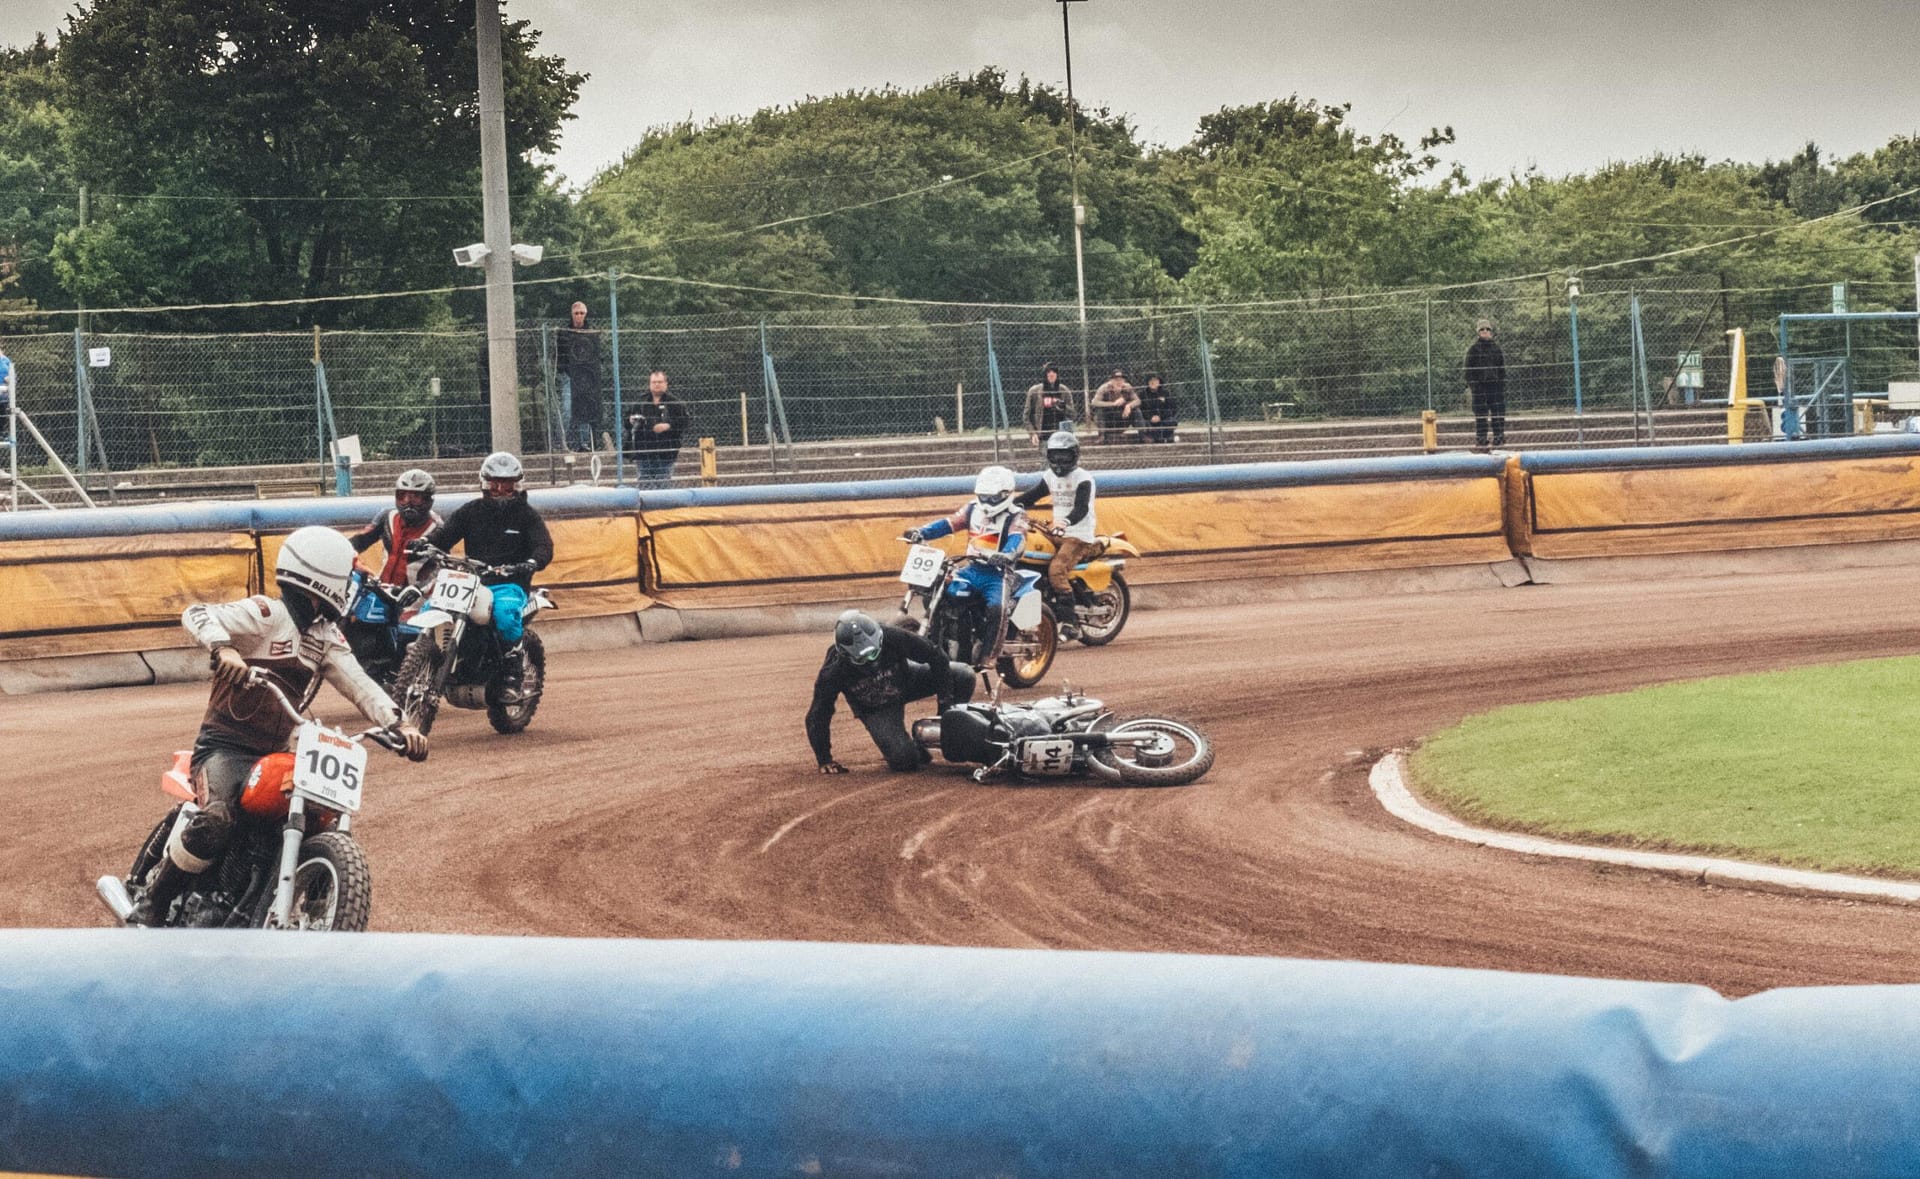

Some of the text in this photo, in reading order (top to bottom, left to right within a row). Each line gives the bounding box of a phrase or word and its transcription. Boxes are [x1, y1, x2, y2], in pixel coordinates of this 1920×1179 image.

[912, 557, 934, 572] 99
[311, 580, 332, 597] BELL
[439, 583, 474, 601] 107
[1042, 746, 1062, 771] 114
[305, 749, 359, 791] 105
